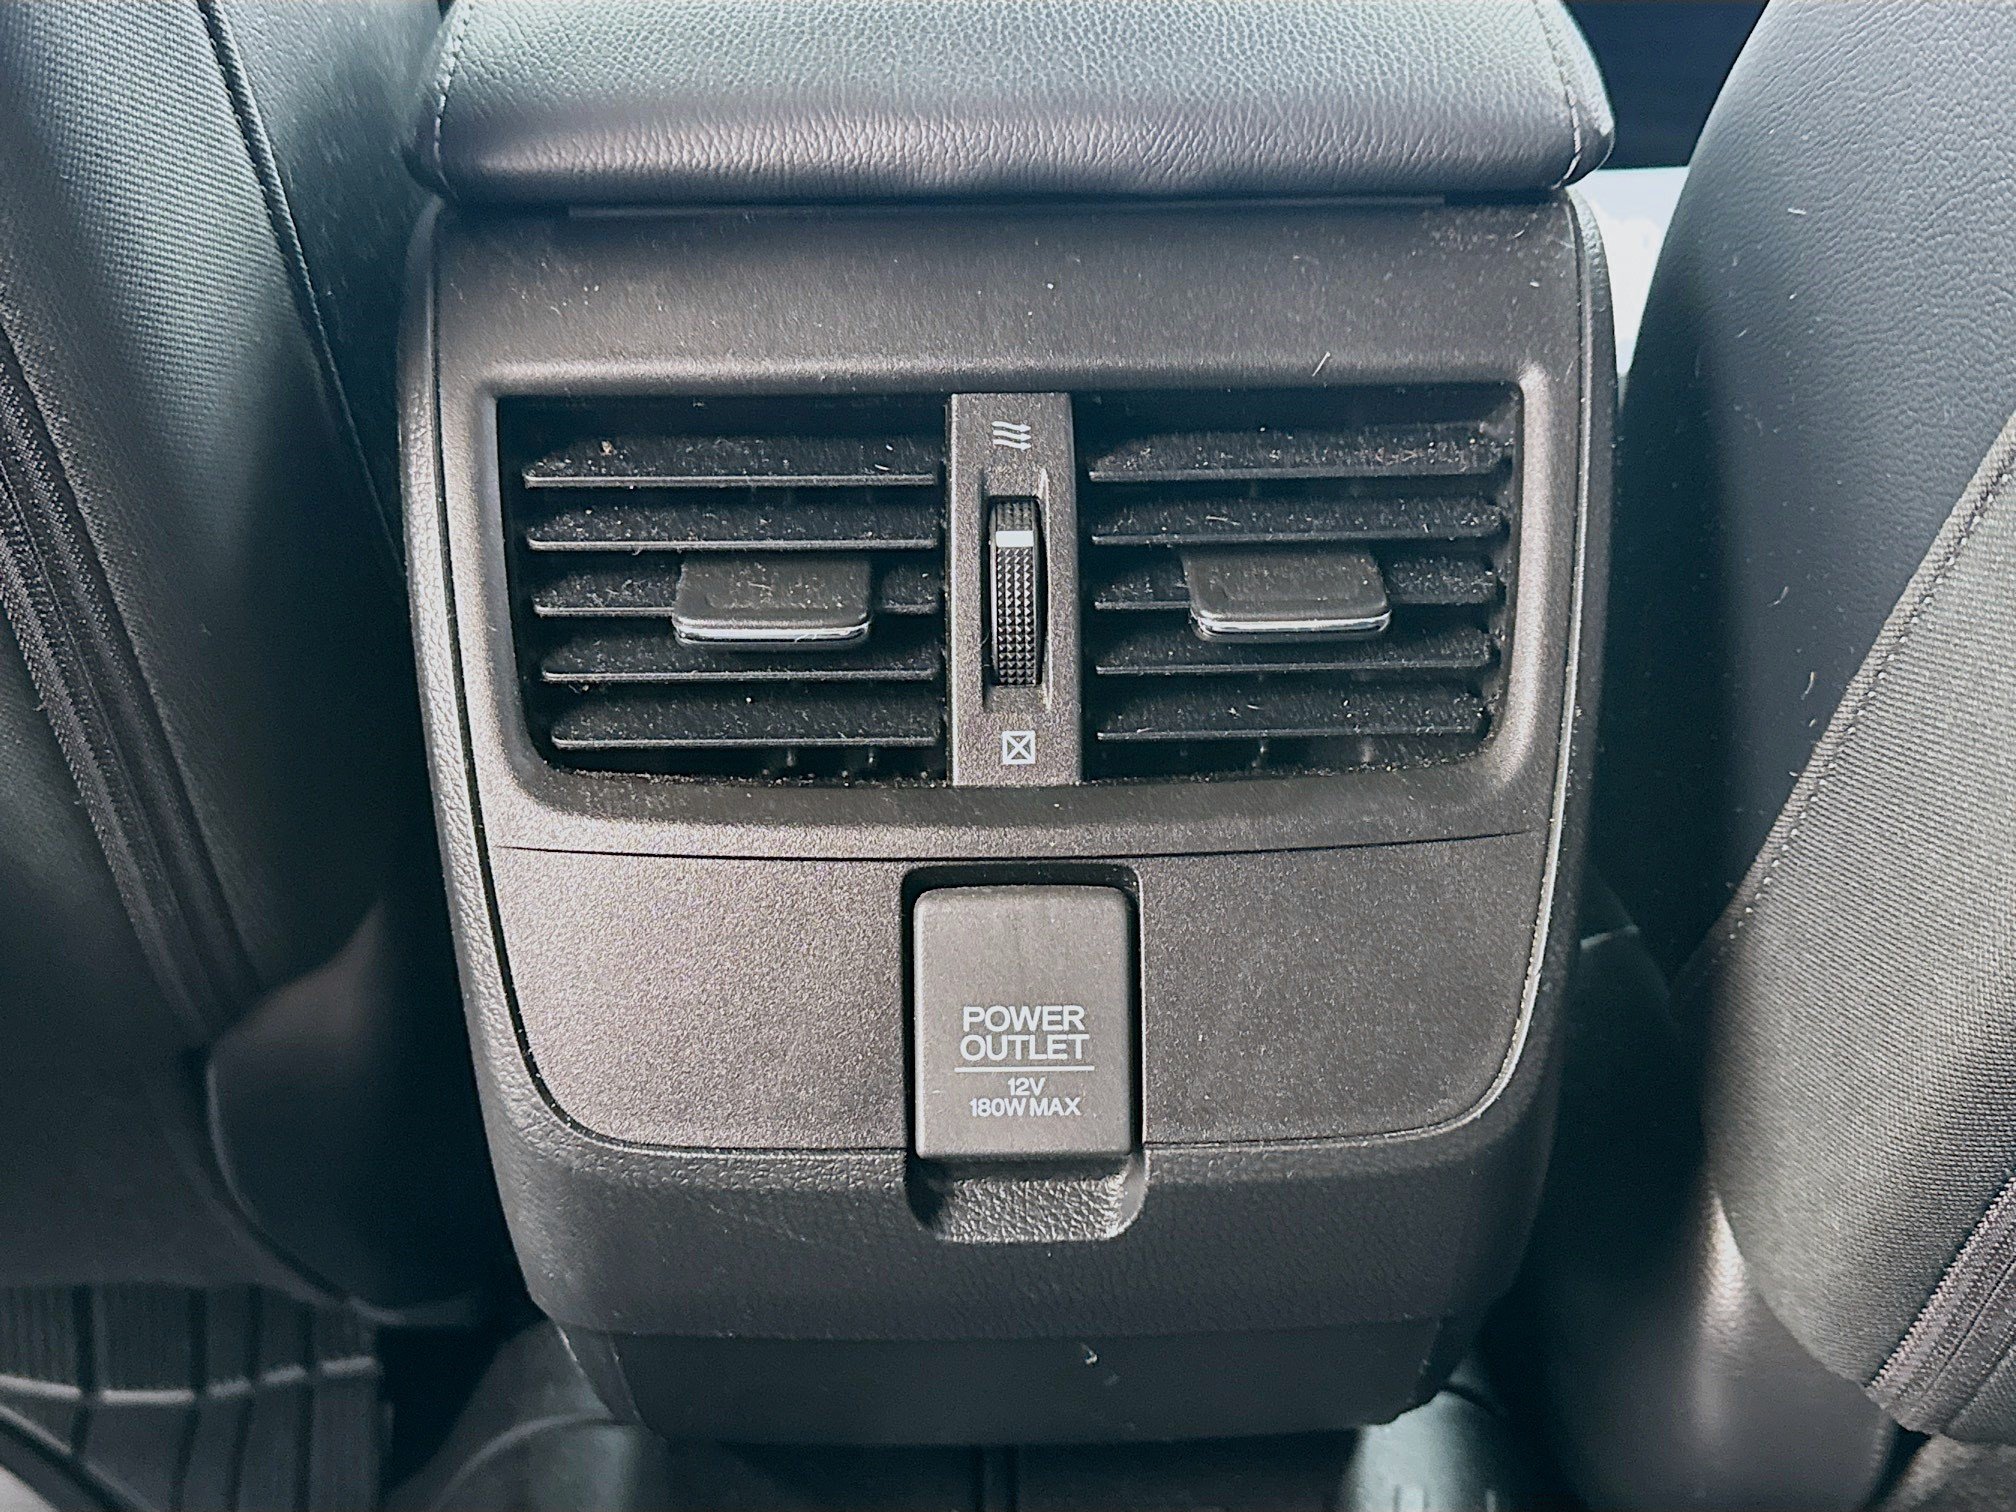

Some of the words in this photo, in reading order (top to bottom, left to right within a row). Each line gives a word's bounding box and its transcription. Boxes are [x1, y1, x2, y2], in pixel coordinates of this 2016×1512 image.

[963, 1005, 1085, 1032] POWER
[960, 1034, 1090, 1061] OUTLET
[1008, 1077, 1046, 1096] 12V
[969, 1097, 1027, 1117] 180W
[1029, 1097, 1082, 1117] MAX
